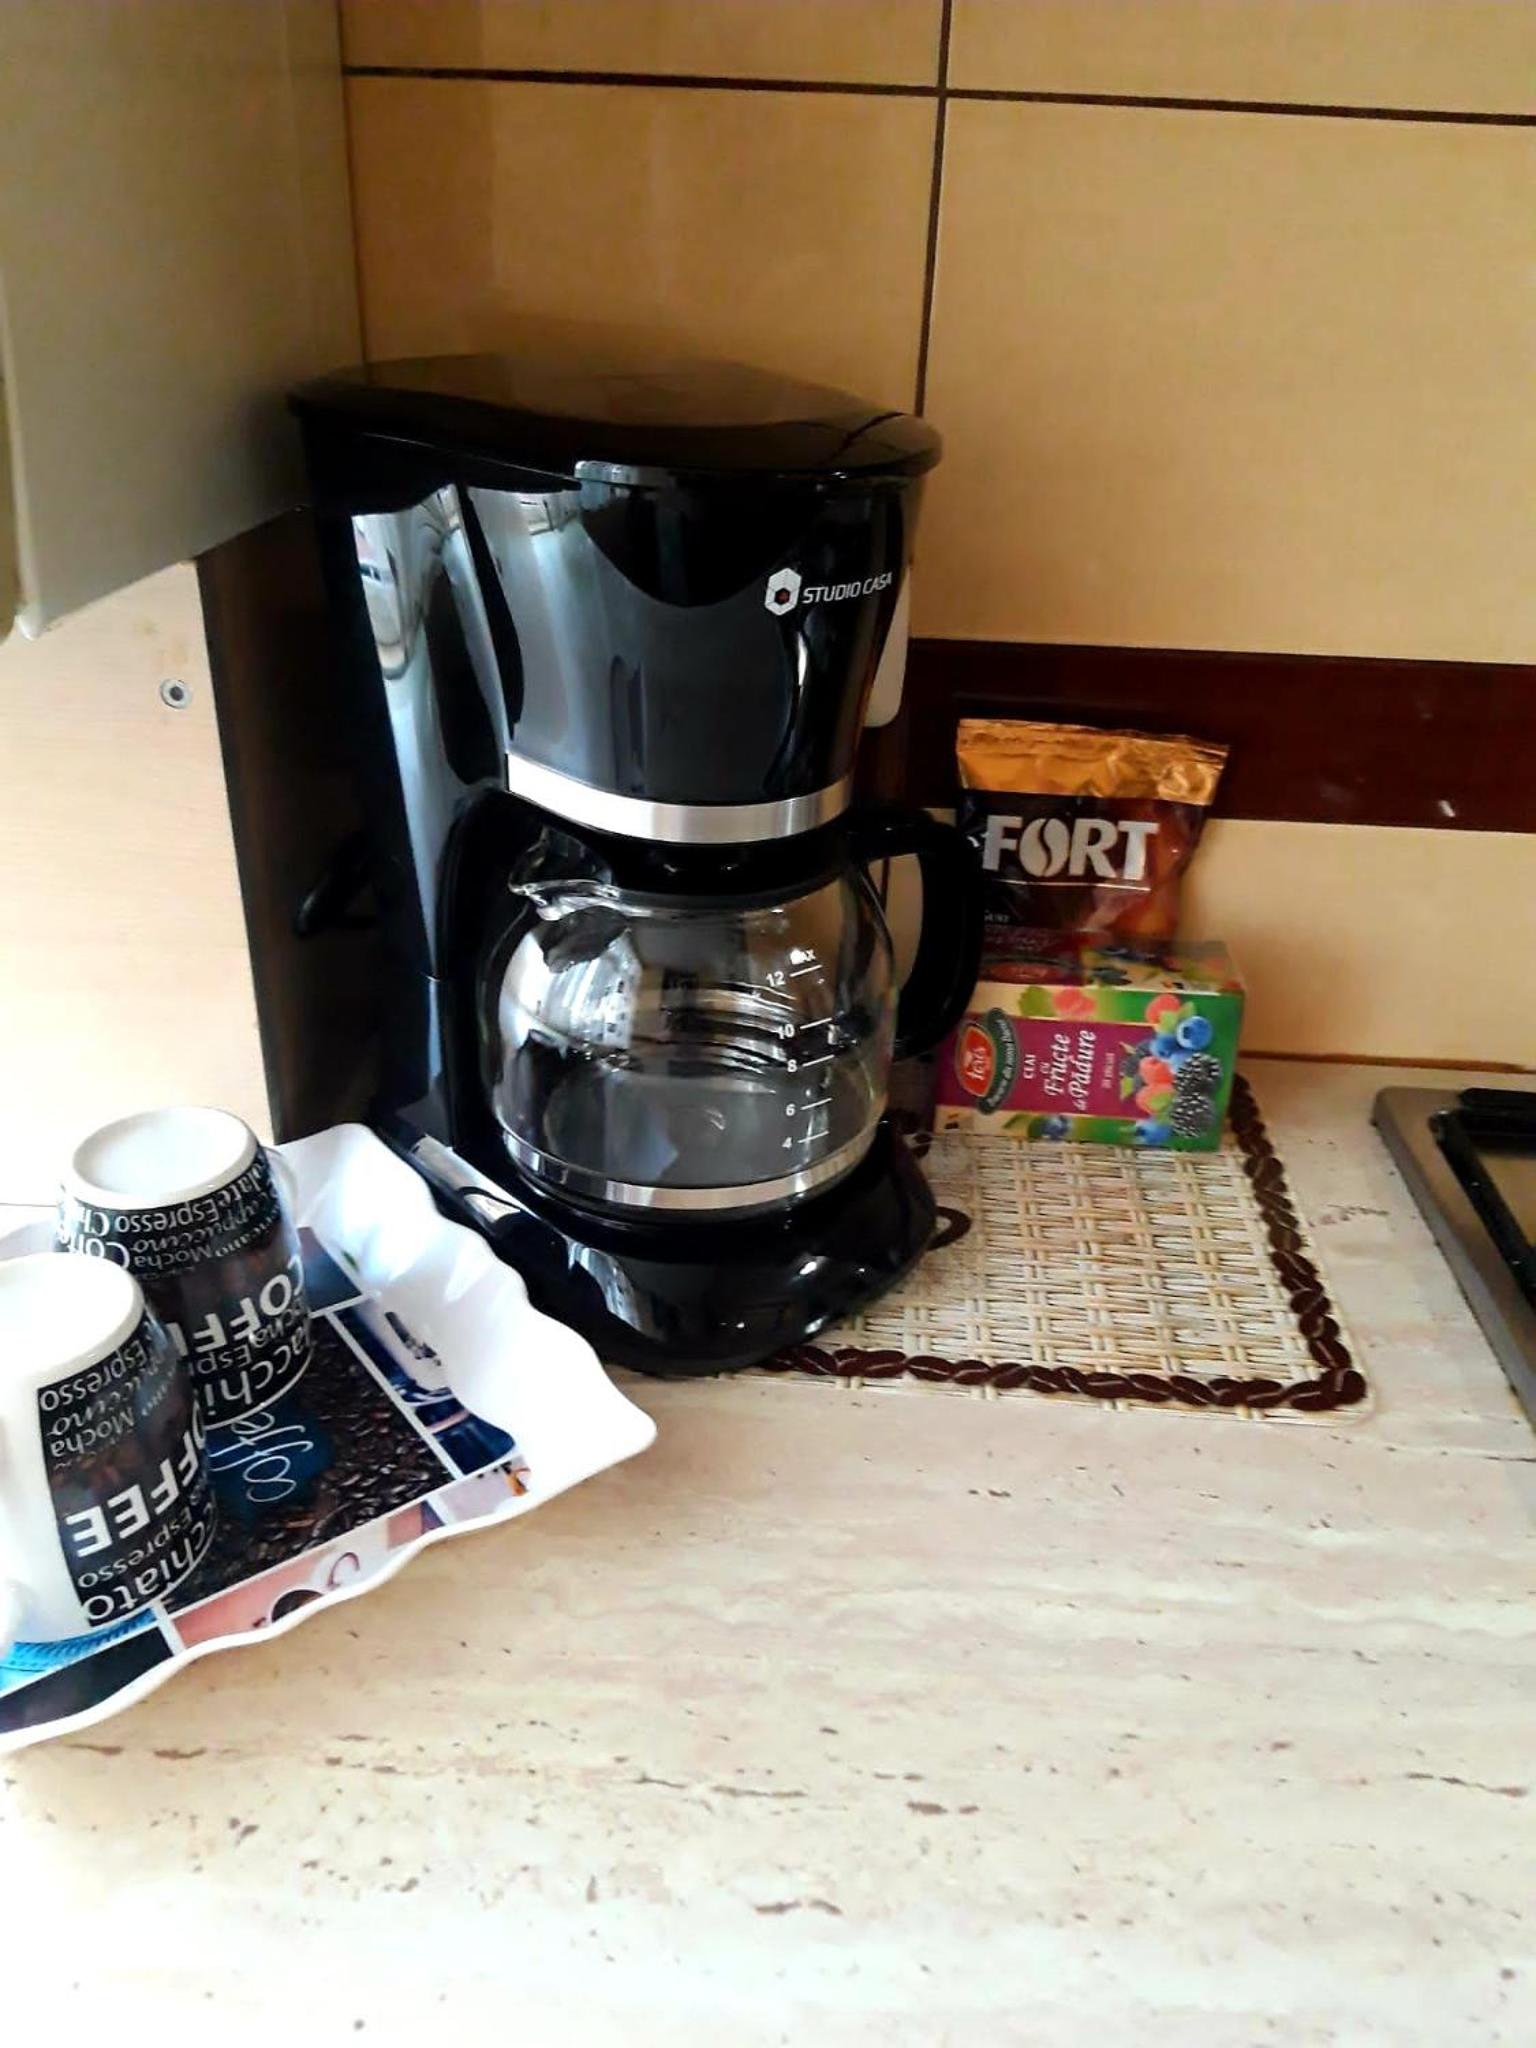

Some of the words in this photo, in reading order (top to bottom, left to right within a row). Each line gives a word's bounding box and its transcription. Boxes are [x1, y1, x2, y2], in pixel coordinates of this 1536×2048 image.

[802, 581, 861, 604] STUDIO
[862, 571, 893, 595] CASA
[982, 814, 1160, 881] FORT
[766, 970, 786, 988] 12
[777, 1024, 796, 1040] 10
[786, 1058, 798, 1073] 8
[1043, 1033, 1072, 1096] Fructe
[785, 1103, 796, 1117] 6
[781, 1136, 793, 1149] 4
[114, 1199, 220, 1234] Espresso
[134, 1243, 213, 1270] Mocha
[39, 1339, 148, 1412] Espresso
[50, 1406, 135, 1458] Mocha
[78, 1506, 193, 1588] Espresso
